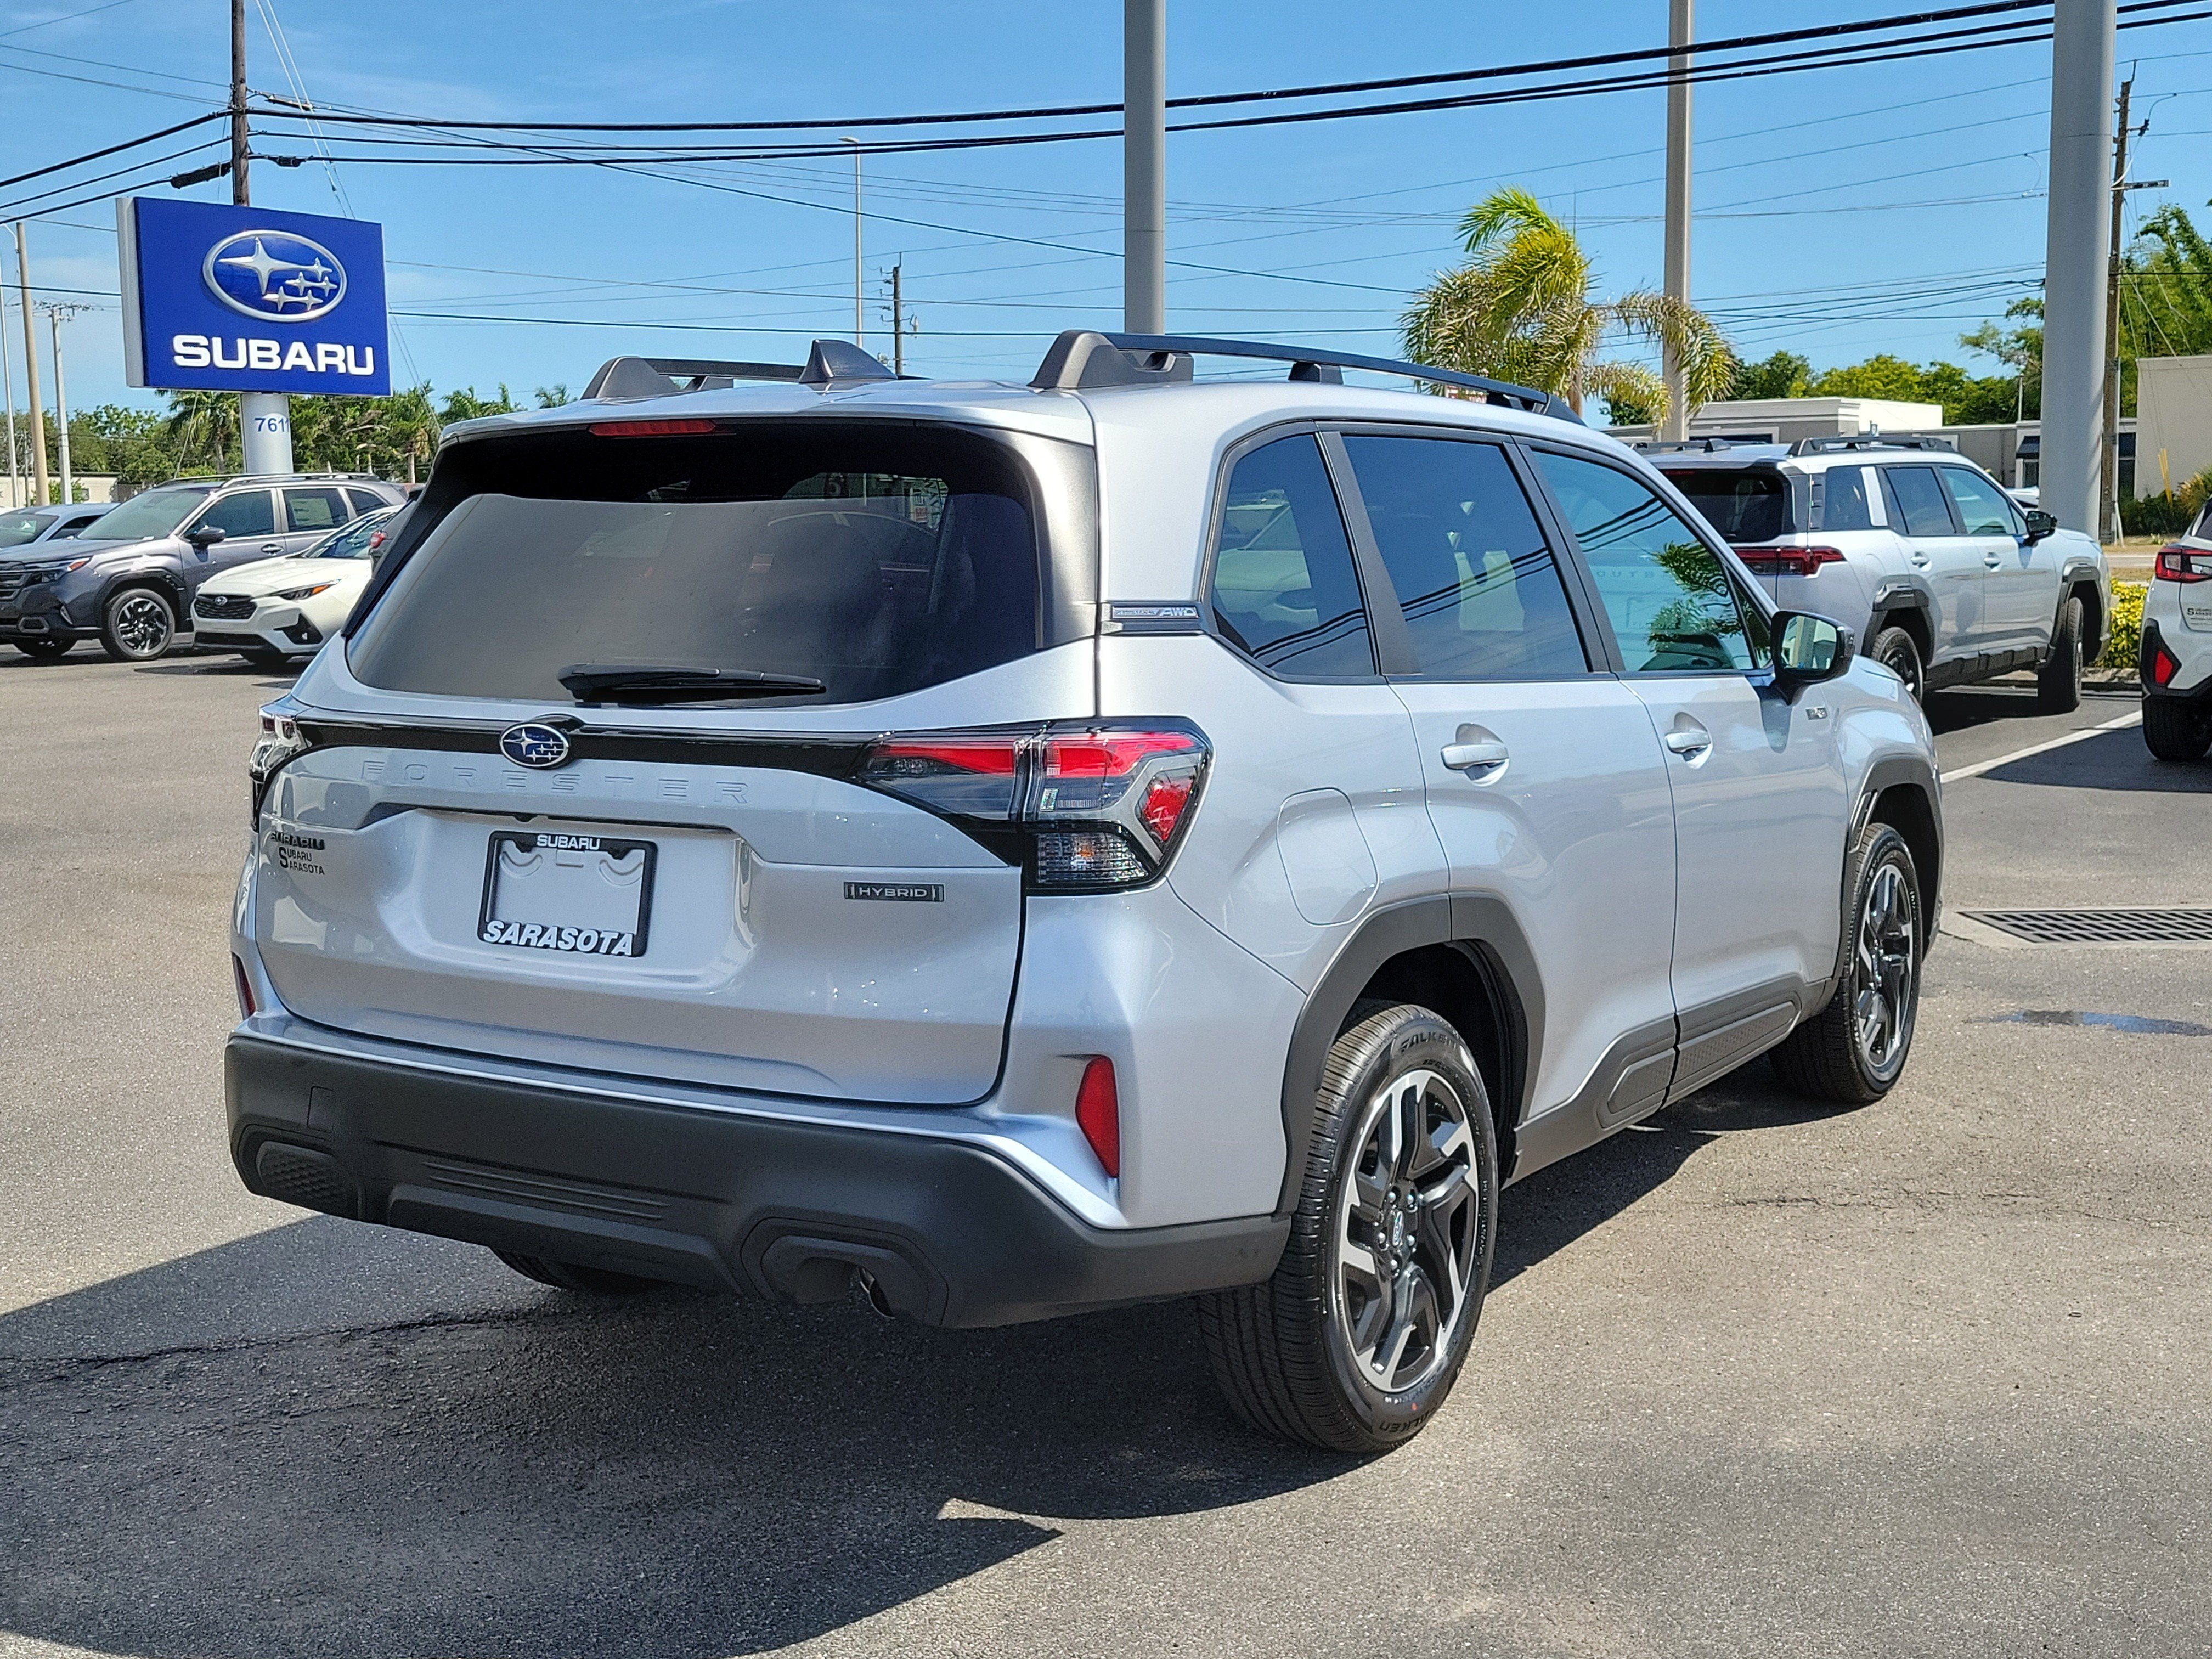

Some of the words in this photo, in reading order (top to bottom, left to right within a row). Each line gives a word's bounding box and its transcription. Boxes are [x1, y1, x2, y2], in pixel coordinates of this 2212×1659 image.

[173, 334, 375, 375] SUBARU
[1160, 607, 1197, 616] AWD
[361, 761, 748, 804] FORESTER
[537, 834, 600, 849] SUBARU
[859, 887, 927, 897] HYBRID
[483, 920, 633, 955] SARASOTA
[1400, 1031, 1457, 1052] FALKEN
